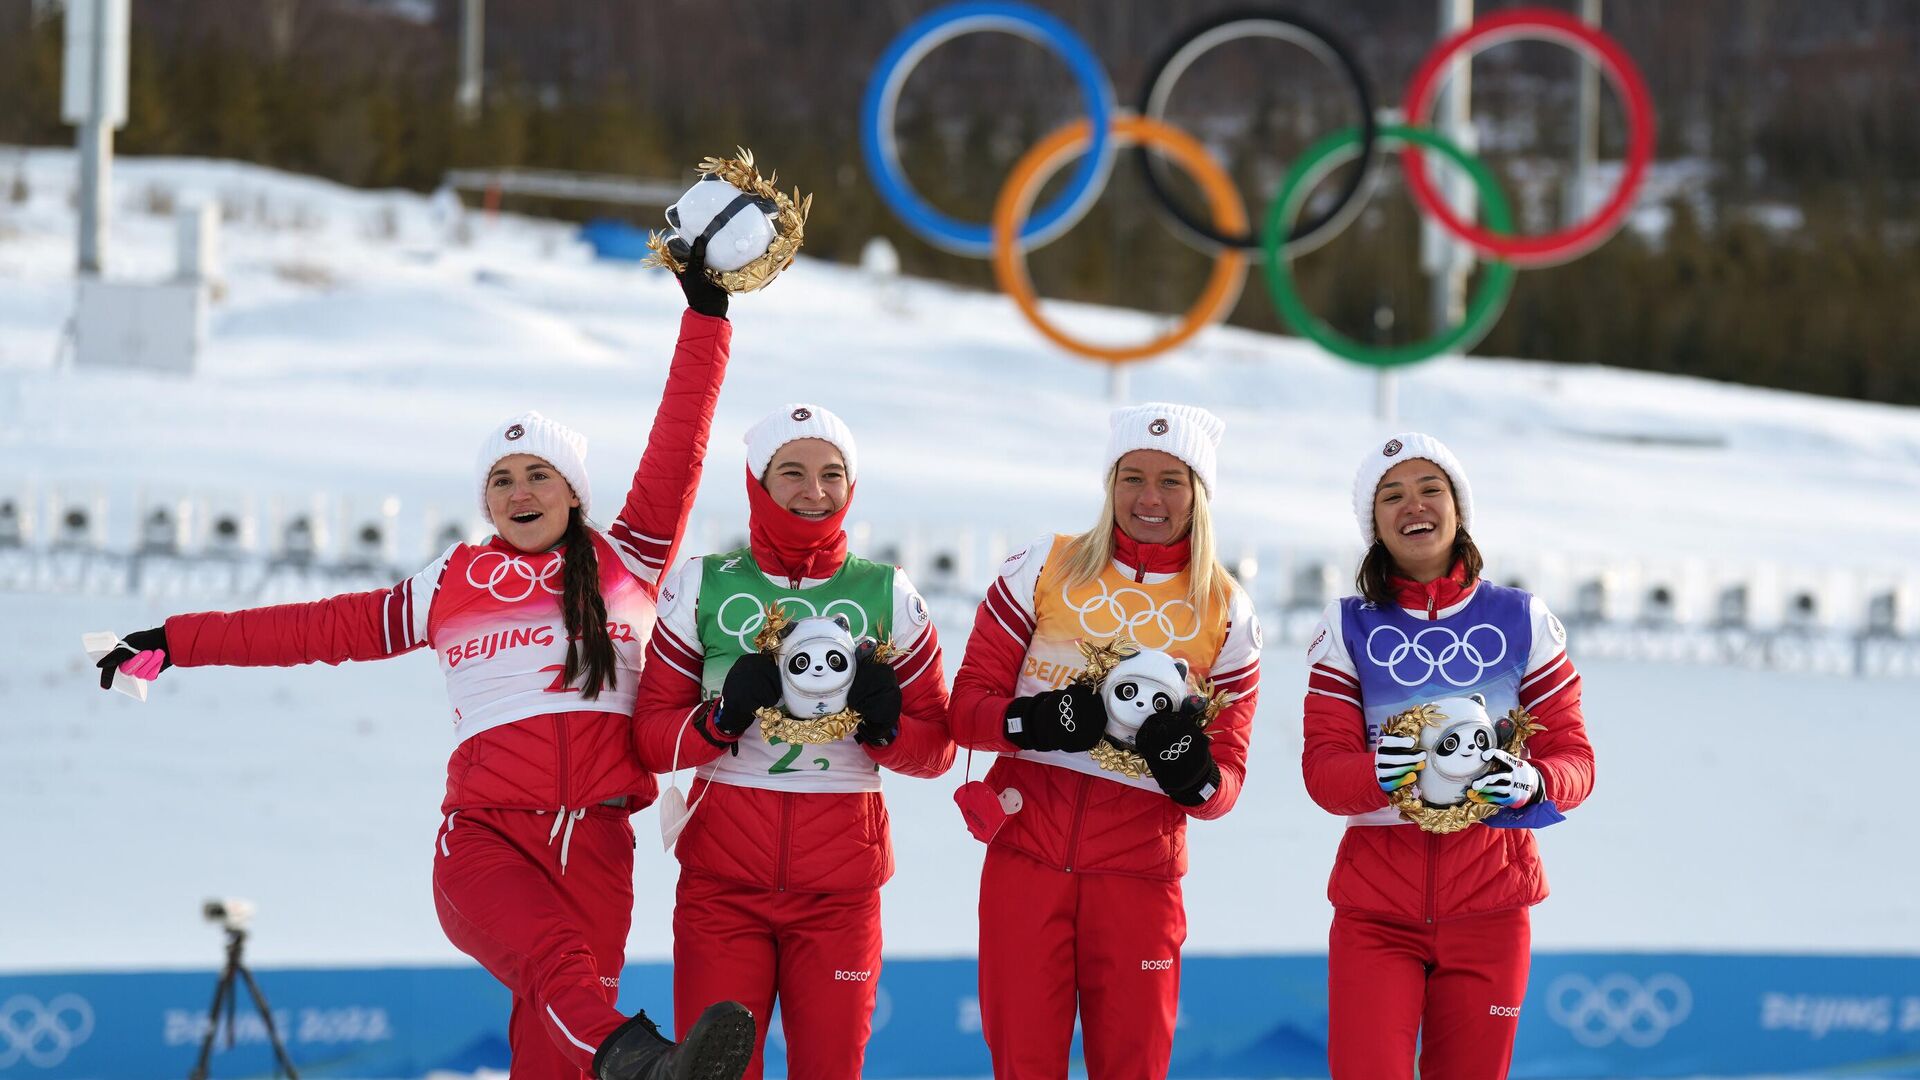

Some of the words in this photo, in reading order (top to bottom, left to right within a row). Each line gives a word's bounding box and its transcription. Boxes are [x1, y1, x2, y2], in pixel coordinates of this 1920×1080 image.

[446, 625, 554, 668] BEIJING
[768, 735, 804, 775] 2
[1141, 959, 1171, 970] BOSCO
[834, 969, 868, 982] BOSCO
[1489, 1004, 1520, 1017] BOSCO
